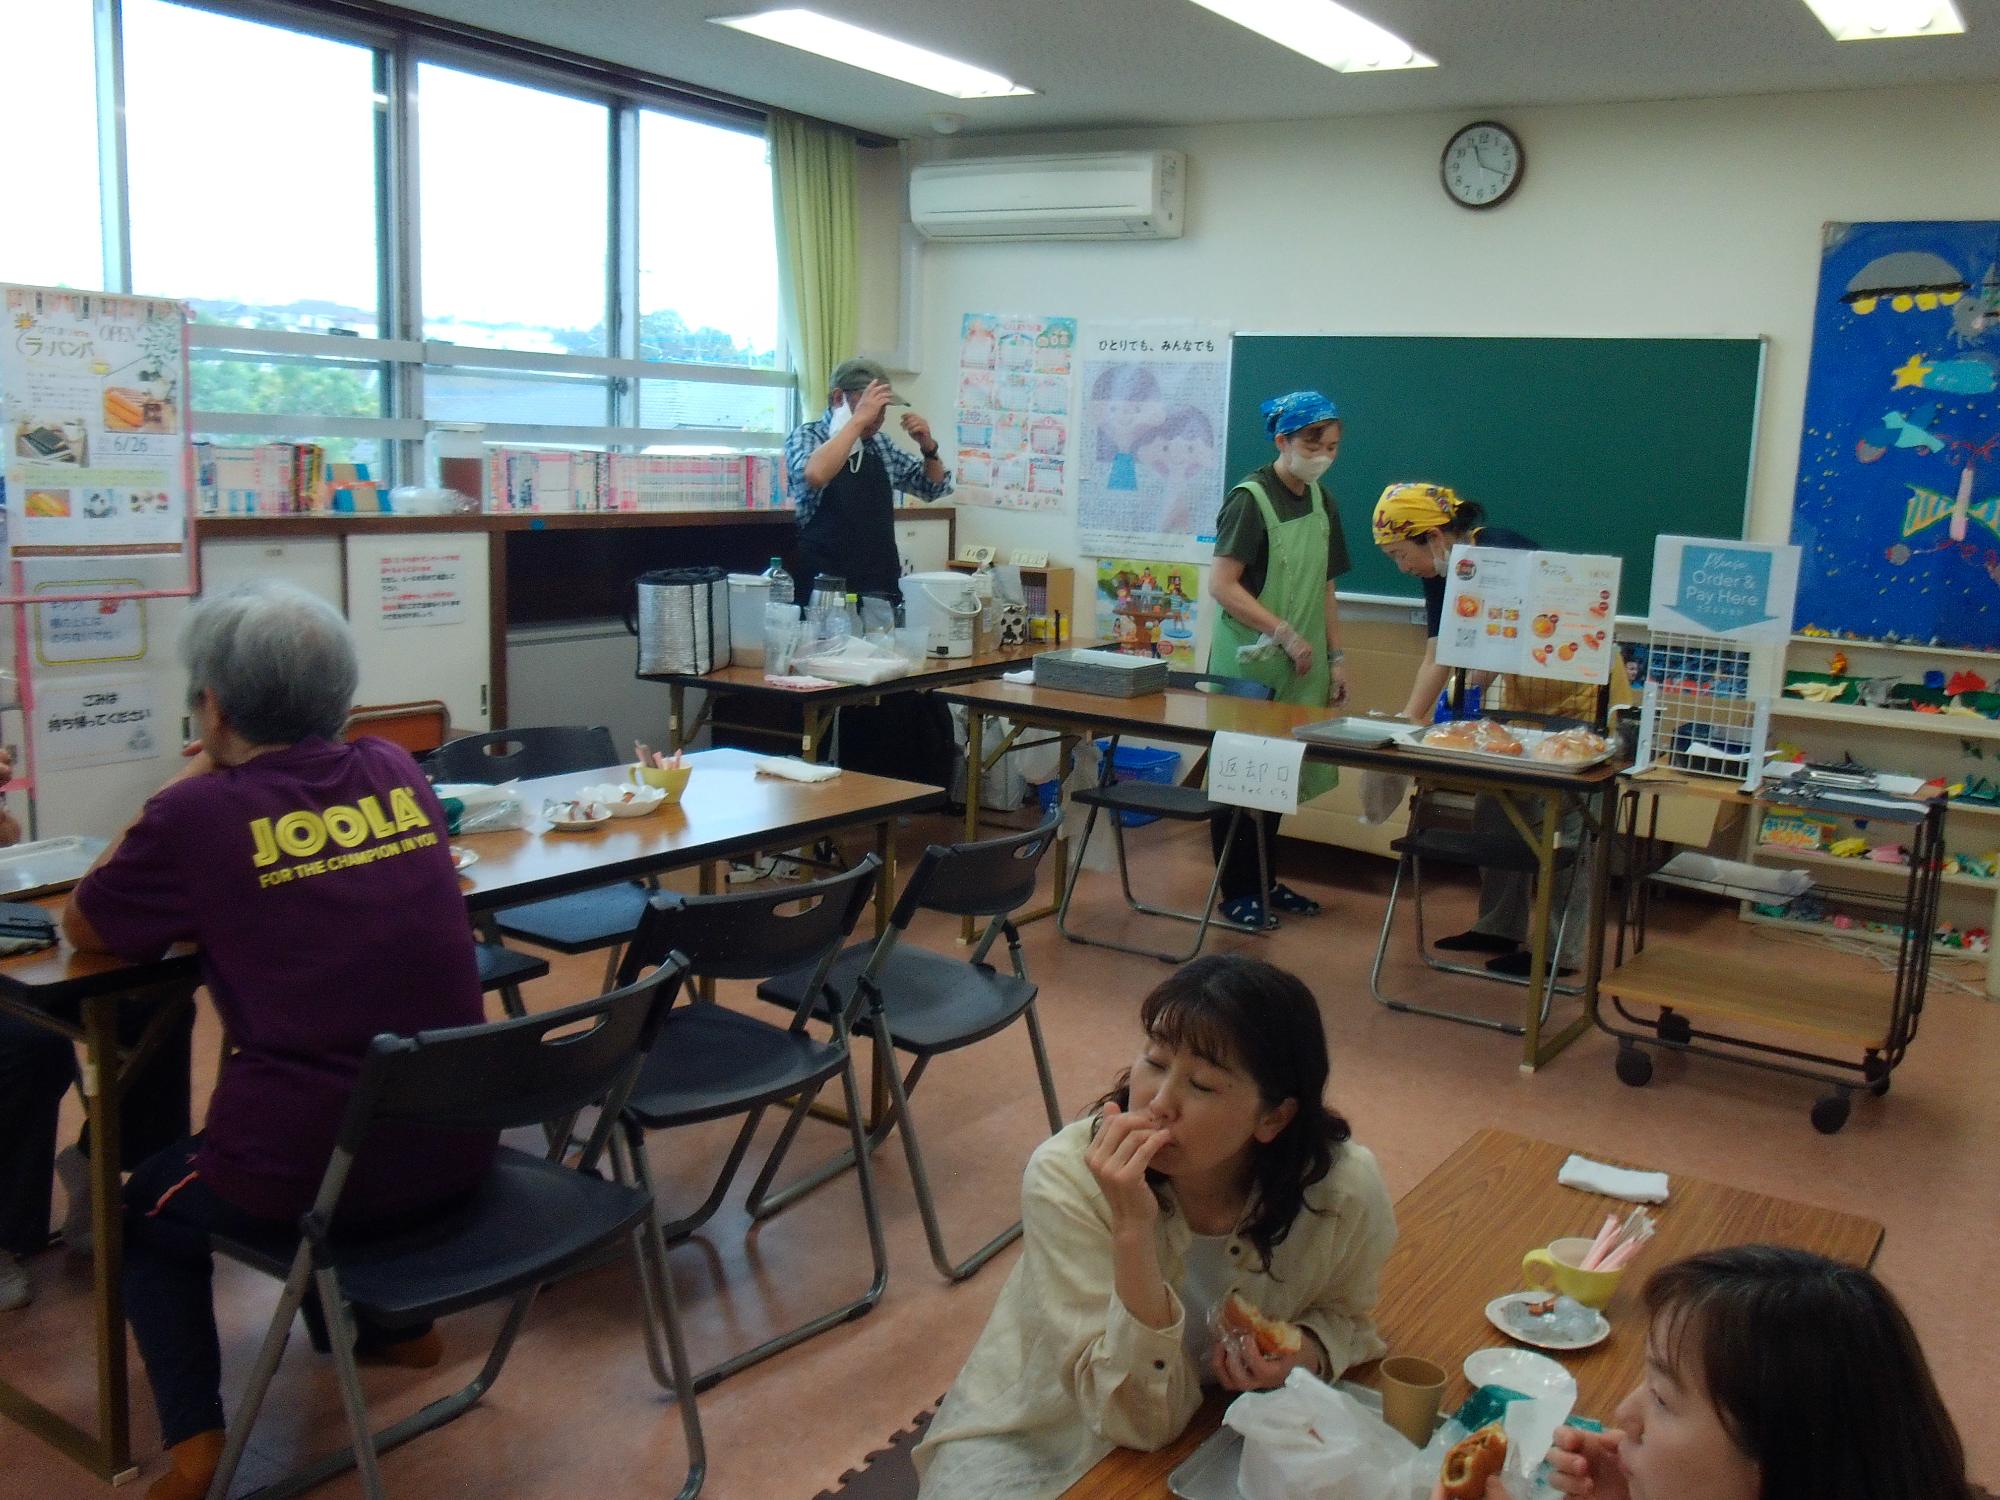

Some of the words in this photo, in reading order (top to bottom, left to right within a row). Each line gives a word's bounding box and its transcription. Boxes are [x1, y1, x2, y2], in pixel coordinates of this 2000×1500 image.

[1692, 569, 1741, 588] Order
[1743, 574, 1756, 590] &
[1686, 585, 1714, 605] Pay
[1717, 588, 1761, 607] Here
[1218, 756, 1289, 783] 返却口
[250, 786, 430, 868] JOOLA
[259, 867, 295, 889] FOR
[294, 860, 328, 879] THE
[327, 841, 401, 872] CHAMPION
[399, 836, 417, 853] IN
[416, 832, 439, 850] YOU
